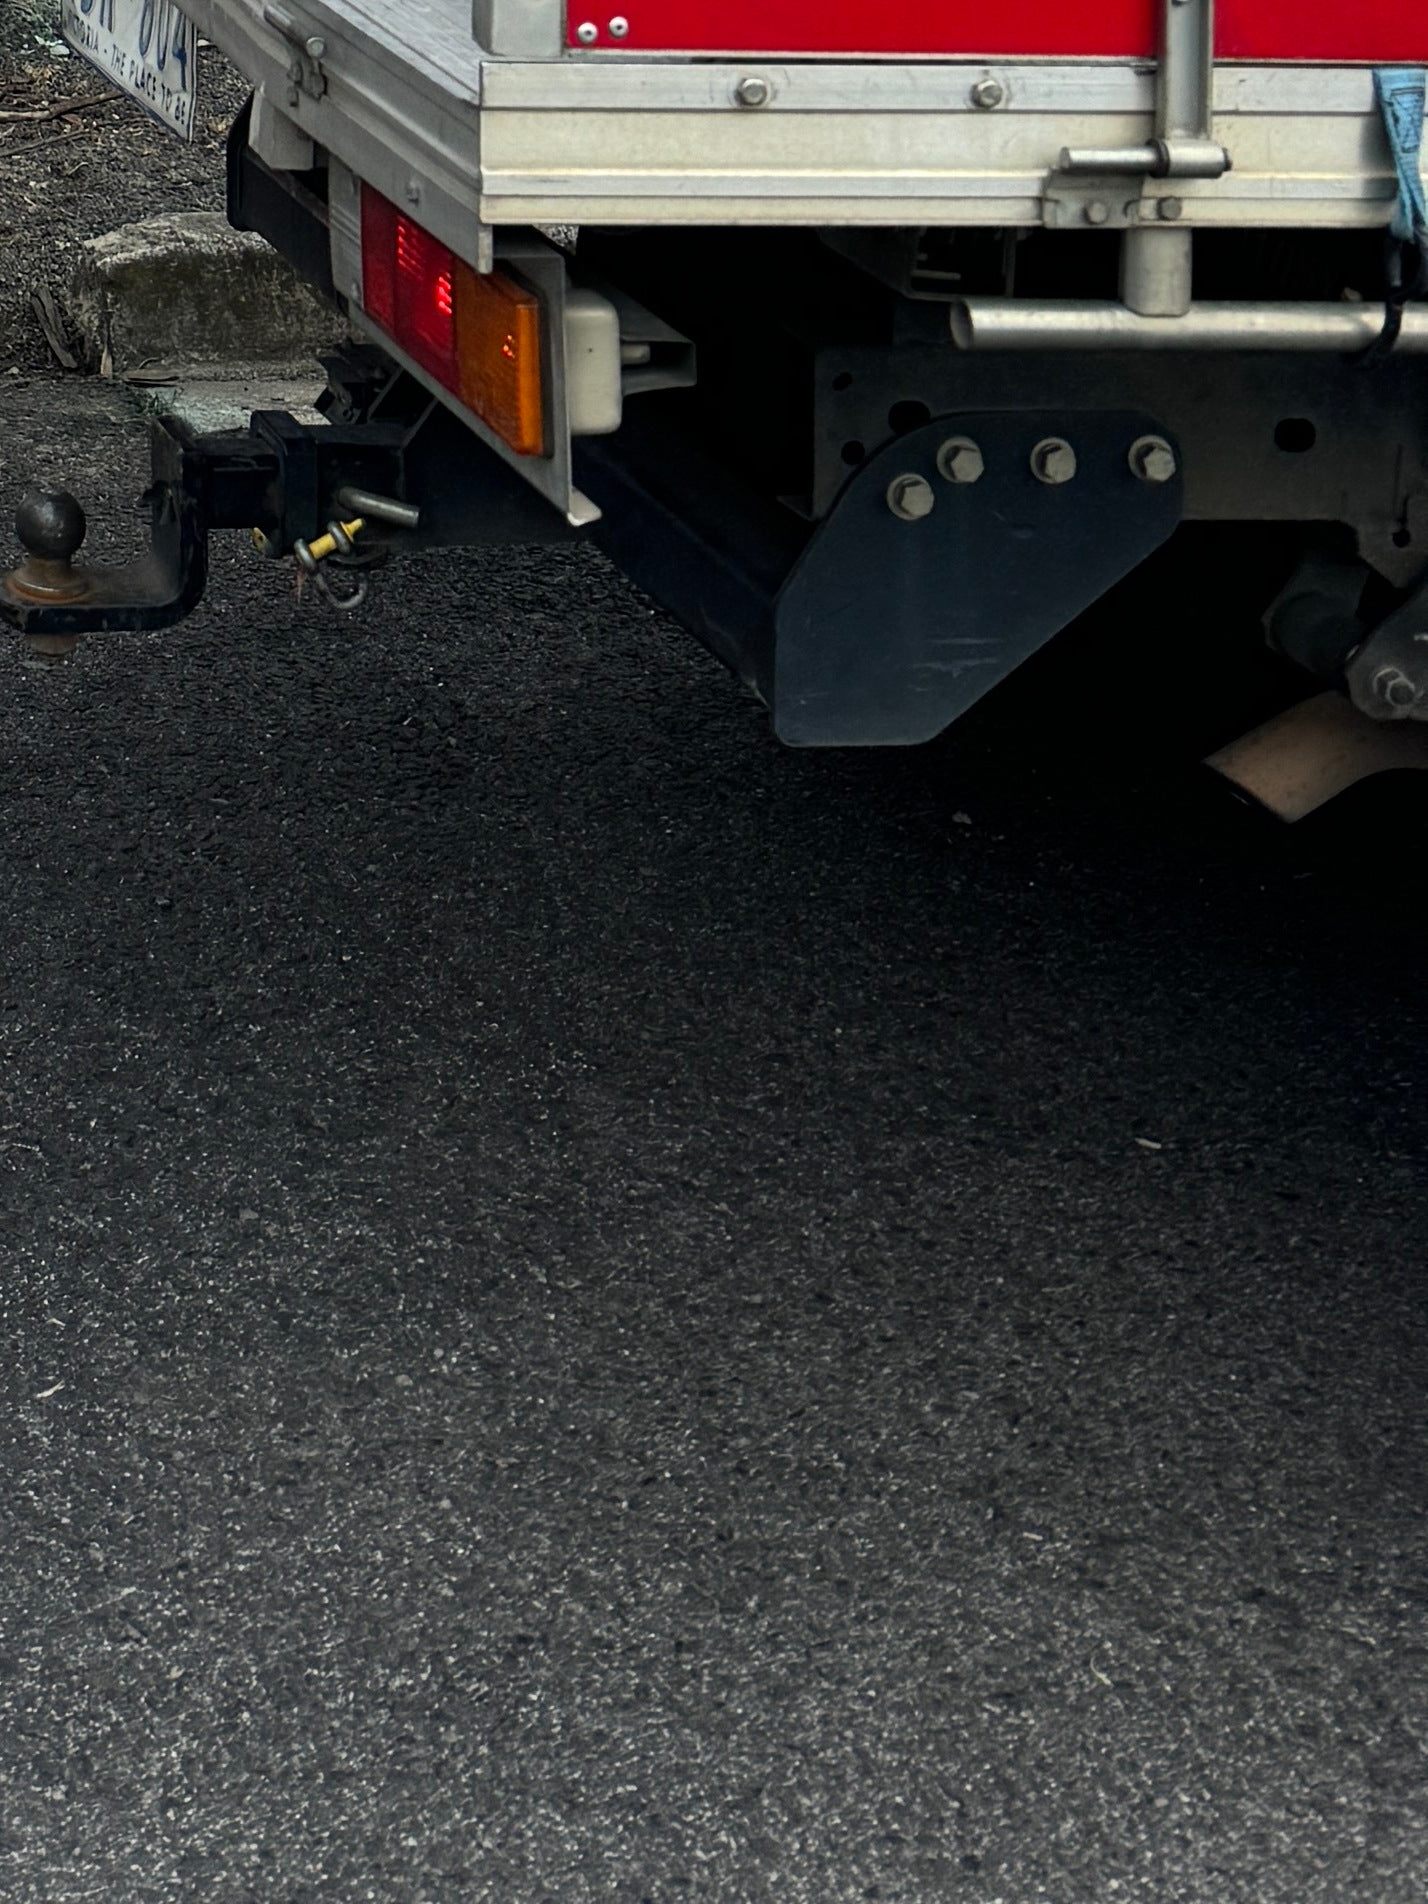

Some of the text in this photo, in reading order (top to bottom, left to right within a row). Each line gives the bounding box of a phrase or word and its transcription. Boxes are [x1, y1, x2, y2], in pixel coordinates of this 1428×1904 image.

[111, 43, 127, 76] THE
[129, 58, 156, 101] PLACE
[161, 82, 173, 112] TO
[175, 95, 186, 125] BE
